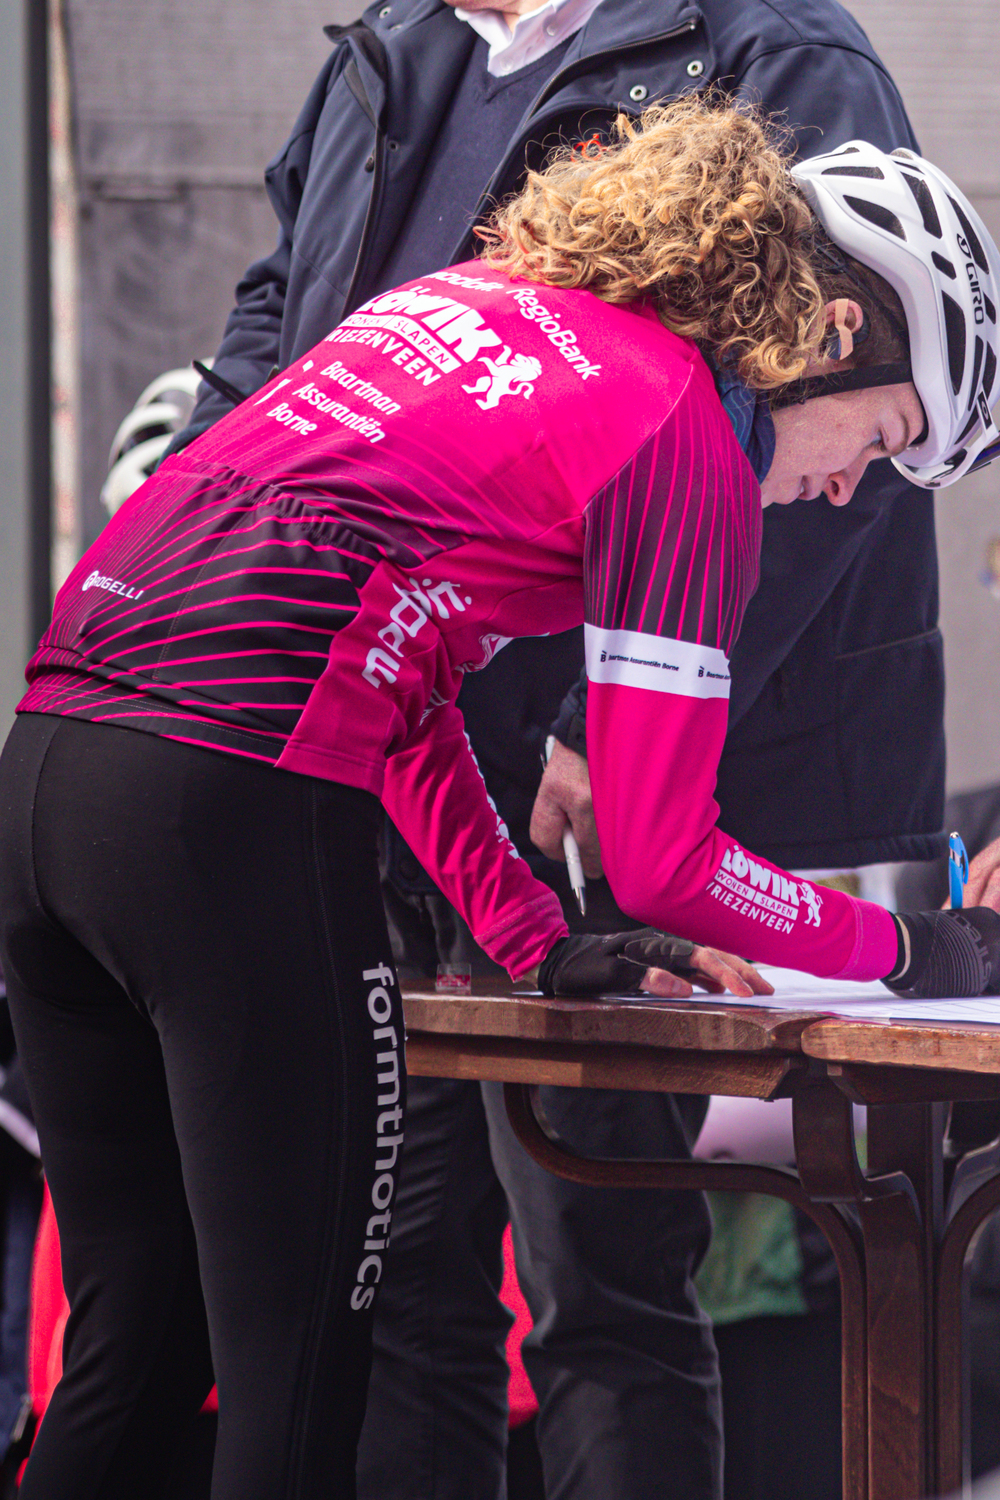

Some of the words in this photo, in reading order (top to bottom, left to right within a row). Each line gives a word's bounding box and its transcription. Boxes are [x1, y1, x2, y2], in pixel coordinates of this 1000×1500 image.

[965, 262, 985, 325] GIRO
[393, 319, 450, 366] SLAPEN
[506, 288, 601, 380] RegioBank
[291, 382, 386, 444] Assurantiën
[319, 361, 401, 415] Baartman
[266, 402, 318, 436] Borne
[91, 576, 145, 601] ROGELLI
[661, 661, 680, 672] Borne
[716, 869, 749, 897] WONEN
[759, 896, 794, 918] SLAPEN
[350, 961, 404, 1311] formthotics
